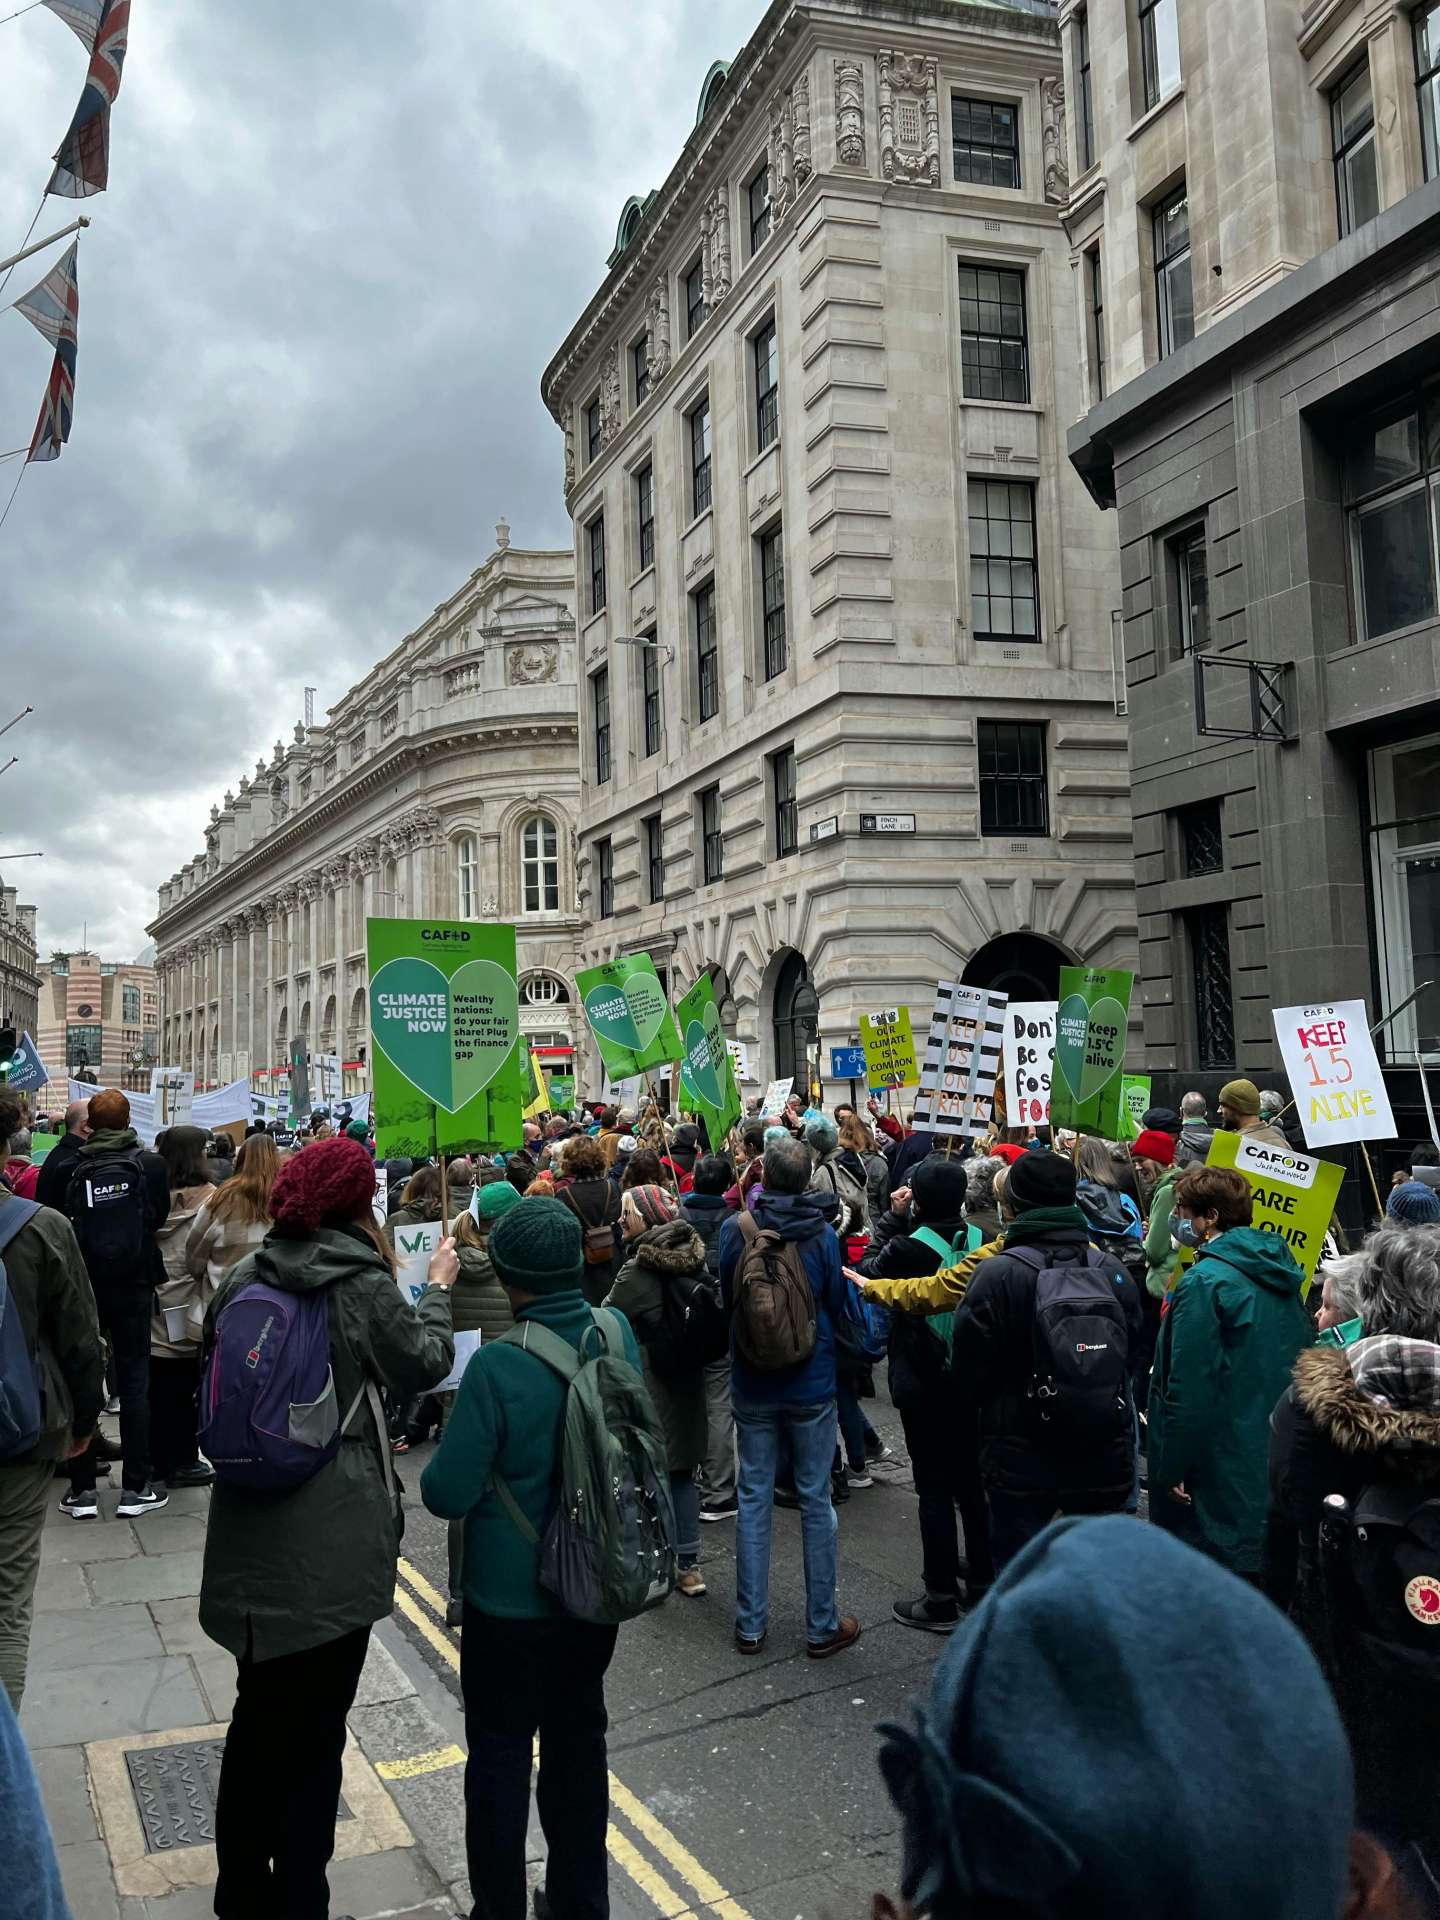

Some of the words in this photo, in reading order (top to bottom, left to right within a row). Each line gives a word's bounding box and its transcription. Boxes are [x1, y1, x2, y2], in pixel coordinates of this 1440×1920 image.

[378, 994, 446, 1005] CLIMATE
[453, 995, 494, 1005] Wealthy
[590, 997, 624, 1013] CLIMATE
[383, 1007, 446, 1019] JUSTICE
[453, 1006, 492, 1014] nations:
[594, 1003, 627, 1019] JUSTICE
[608, 1010, 628, 1021] NOW
[408, 1021, 446, 1032] NOW
[454, 1017, 466, 1025] do
[469, 1019, 490, 1027] your
[493, 1017, 509, 1025] fair
[946, 1017, 985, 1040] KEEP
[1060, 1018, 1087, 1029] CLIMATE
[454, 1028, 484, 1036] share!
[487, 1028, 508, 1037] Plug
[876, 1026, 895, 1036] OUR
[1061, 1028, 1085, 1039] JUSTICE
[1089, 1021, 1118, 1038] Keep
[1297, 1021, 1346, 1049] KEEP
[454, 1039, 470, 1047] the
[474, 1039, 508, 1047] finance
[870, 1035, 906, 1049] CLIMATE
[1068, 1038, 1084, 1047] NOW
[1088, 1038, 1114, 1052] 1.5°C
[455, 1052, 473, 1060] gap
[882, 1050, 890, 1058] IS
[949, 1046, 970, 1065] US
[1017, 1046, 1037, 1065] Be
[1085, 1053, 1114, 1068] alive
[871, 1057, 912, 1072] COMMON
[1304, 1047, 1352, 1086] 1.5
[945, 1072, 968, 1089] ON
[924, 1089, 987, 1118] TRACK
[1311, 1088, 1376, 1123] ALIVE
[1245, 1146, 1310, 1172] CAFOD
[1256, 1162, 1271, 1171] Just
[1286, 1171, 1306, 1181] world
[1250, 1186, 1298, 1215] ARE
[399, 1231, 432, 1253] WE
